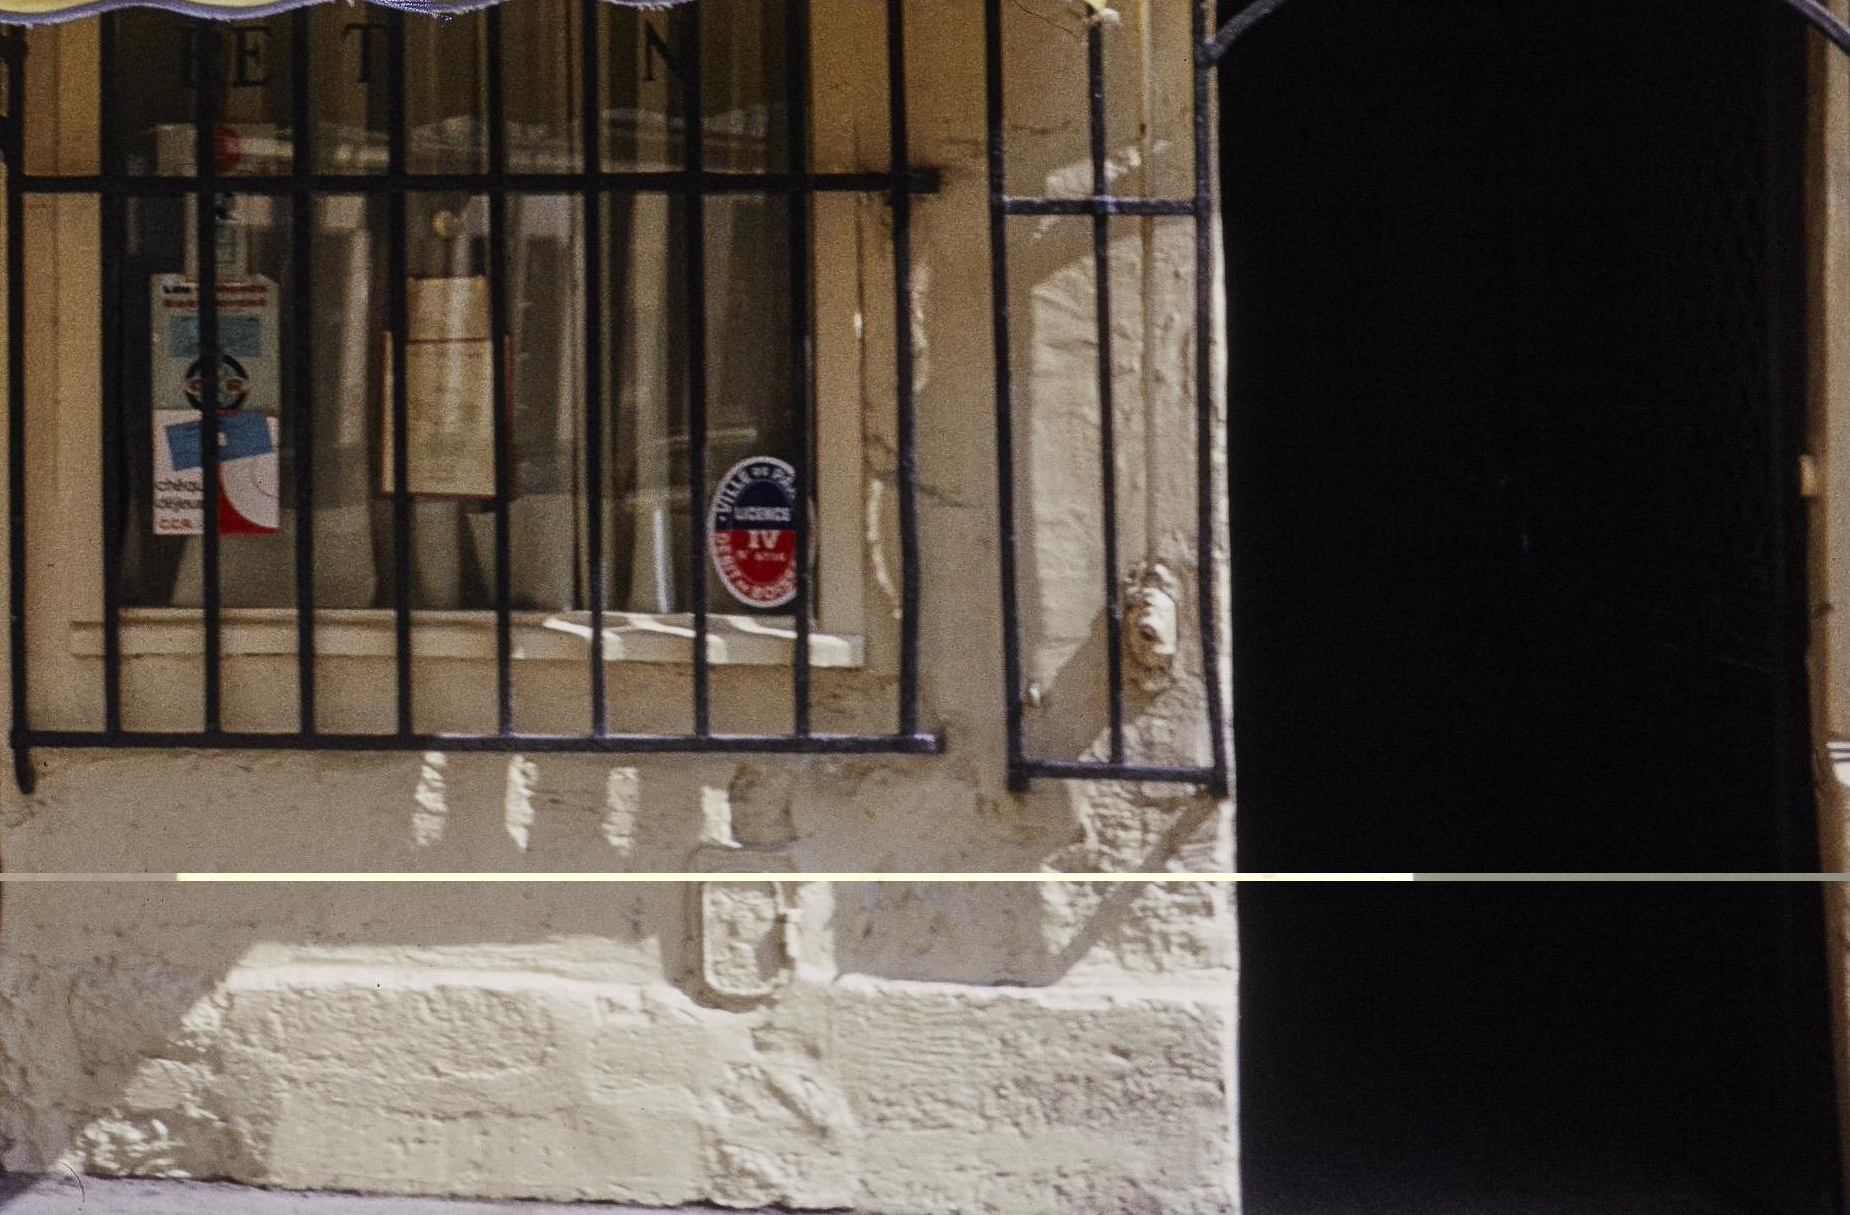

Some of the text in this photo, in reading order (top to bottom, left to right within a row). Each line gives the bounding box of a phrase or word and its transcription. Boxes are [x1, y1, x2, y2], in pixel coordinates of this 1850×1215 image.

[716, 469, 752, 513] VILLE
[735, 506, 792, 522] LICENCE
[748, 530, 781, 549] IV
